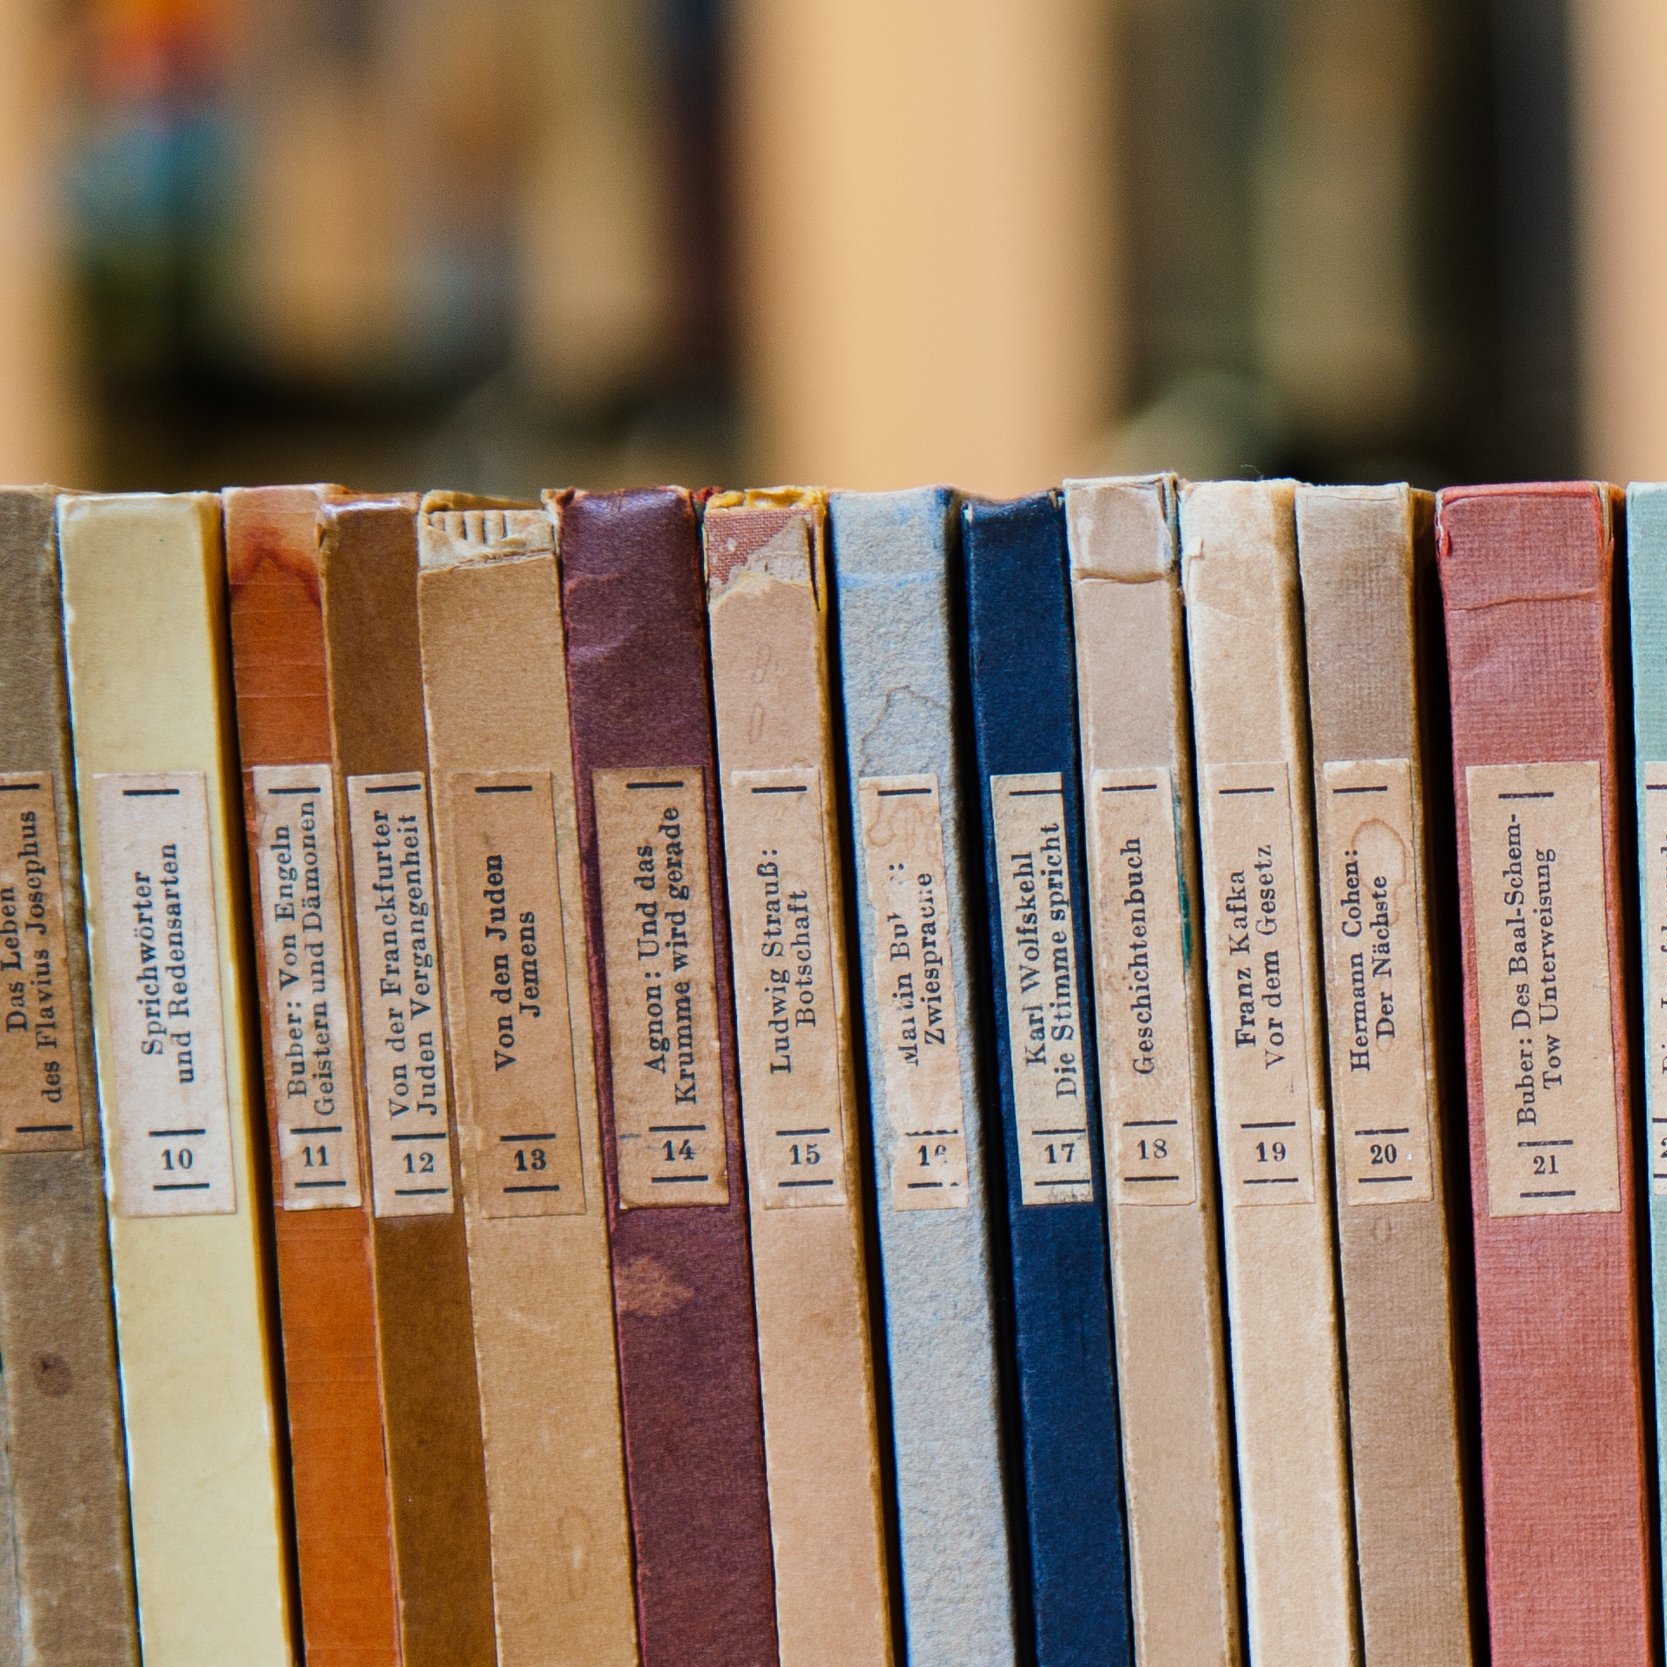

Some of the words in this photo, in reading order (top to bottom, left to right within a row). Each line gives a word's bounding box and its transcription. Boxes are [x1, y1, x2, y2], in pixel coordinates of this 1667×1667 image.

[16, 810, 48, 936] Josephus
[269, 825, 298, 921] Engeln
[301, 800, 323, 933] Dämonen
[633, 844, 656, 891] das
[657, 805, 690, 901] gerade
[1039, 822, 1066, 921] spricht
[1253, 844, 1278, 936] Gesetz
[1340, 849, 1363, 938] Cohen:
[159, 843, 190, 1018] Redensarten
[371, 809, 402, 997] Franckfurter
[396, 814, 433, 1021] Vergangenheit
[482, 854, 508, 942] Juden
[634, 900, 660, 962] Und
[756, 849, 784, 958] Strauß:
[1010, 851, 1041, 994] Wolfskehl
[1225, 870, 1250, 956] Kafka
[1369, 876, 1392, 978] Nächste
[1532, 848, 1559, 1025] Unterweisung
[132, 871, 167, 1056] Sprichwörter
[278, 933, 300, 991] Von
[304, 941, 326, 993] und
[490, 953, 513, 1005] den
[518, 911, 541, 1019] Jemens
[664, 909, 689, 972] wird
[786, 890, 817, 1028] Botschaft
[1119, 837, 1155, 1075] Geschichtenbuch
[1261, 949, 1283, 1008] dem
[30, 948, 58, 1050] Flavius
[764, 968, 792, 1075] Ludwig
[1049, 930, 1075, 1041] Stimme
[1234, 967, 1257, 1048] Franz
[1349, 951, 1371, 1073] Hermann
[1375, 991, 1396, 1041] Der
[1510, 983, 1532, 1030] Des
[170, 1031, 195, 1084] und
[284, 1001, 307, 1099] Buber:
[311, 1001, 335, 1116] Geistern
[384, 1007, 406, 1053] der
[493, 1014, 517, 1072] Von
[673, 979, 697, 1106] Krumme
[1021, 1005, 1047, 1065] Karl
[1265, 1017, 1285, 1070] Vor
[1542, 1033, 1563, 1090] Tow
[40, 1060, 63, 1104] des
[388, 1063, 410, 1117] Von
[414, 1031, 438, 1117] Juden
[1053, 1052, 1077, 1099] Die
[1514, 1038, 1537, 1126] Buber:
[162, 1148, 193, 1171] 10
[302, 1145, 329, 1167] 11
[403, 1152, 434, 1174] 12
[514, 1148, 547, 1172] 13
[662, 1138, 696, 1162] 14
[789, 1143, 821, 1166] 15
[1044, 1142, 1075, 1165] 17
[1137, 1138, 1168, 1160] 18
[1255, 1141, 1286, 1163] 19
[1369, 1143, 1398, 1166] 20
[1533, 1154, 1559, 1175] 21
